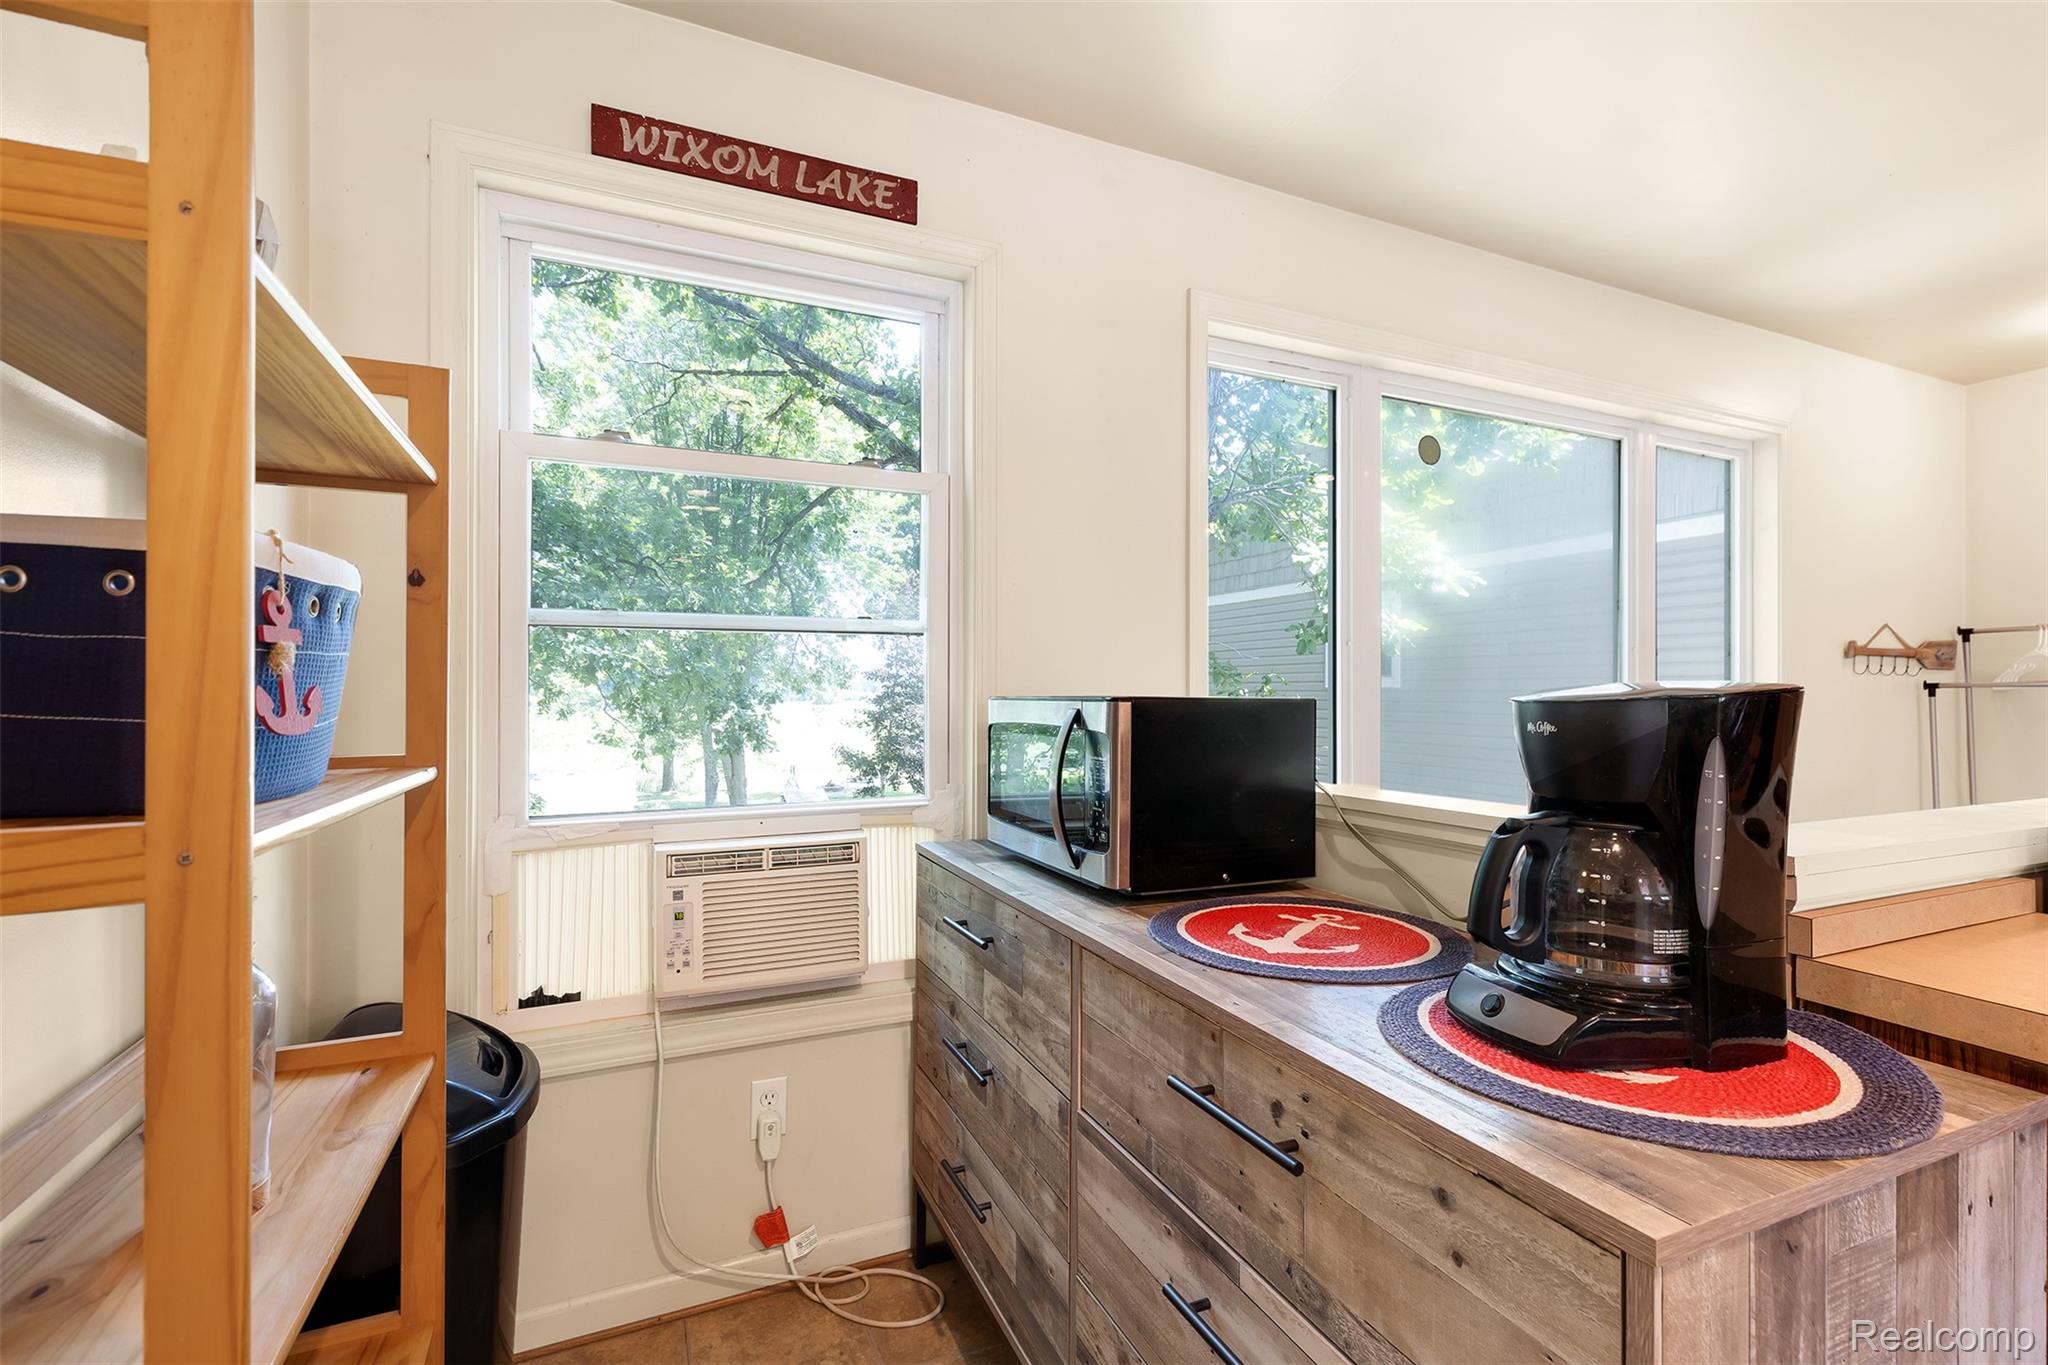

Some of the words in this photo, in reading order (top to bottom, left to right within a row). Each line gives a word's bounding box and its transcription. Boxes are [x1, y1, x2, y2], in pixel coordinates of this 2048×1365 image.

[619, 117, 780, 188] WIXOM
[794, 160, 898, 209] LAKE
[1536, 720, 1558, 736] Coffee
